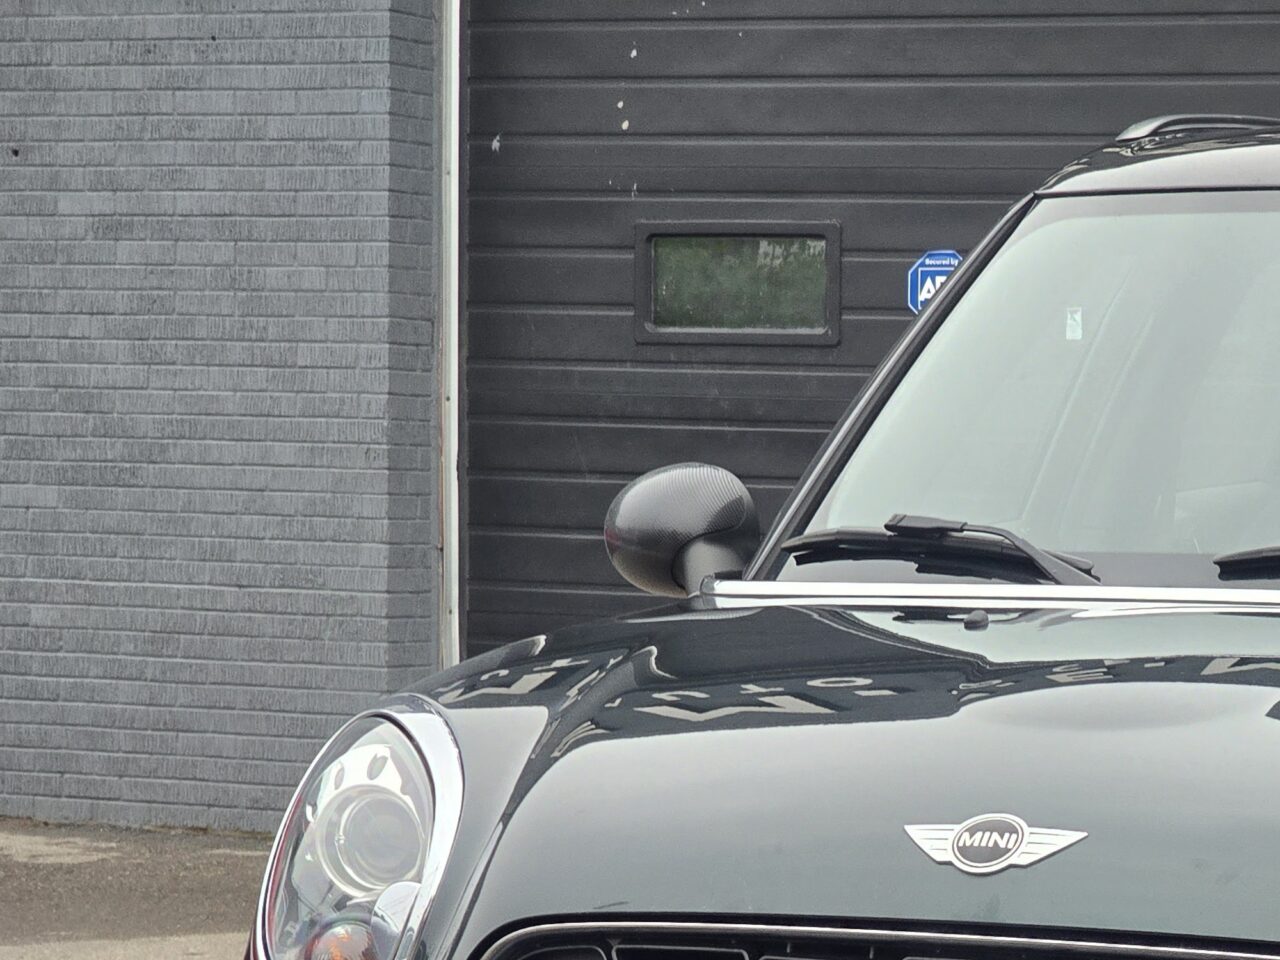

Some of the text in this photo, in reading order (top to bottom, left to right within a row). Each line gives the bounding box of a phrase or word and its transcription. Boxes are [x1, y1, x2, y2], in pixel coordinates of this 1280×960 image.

[925, 257, 959, 267] Secured by
[957, 830, 1018, 849] MINI
